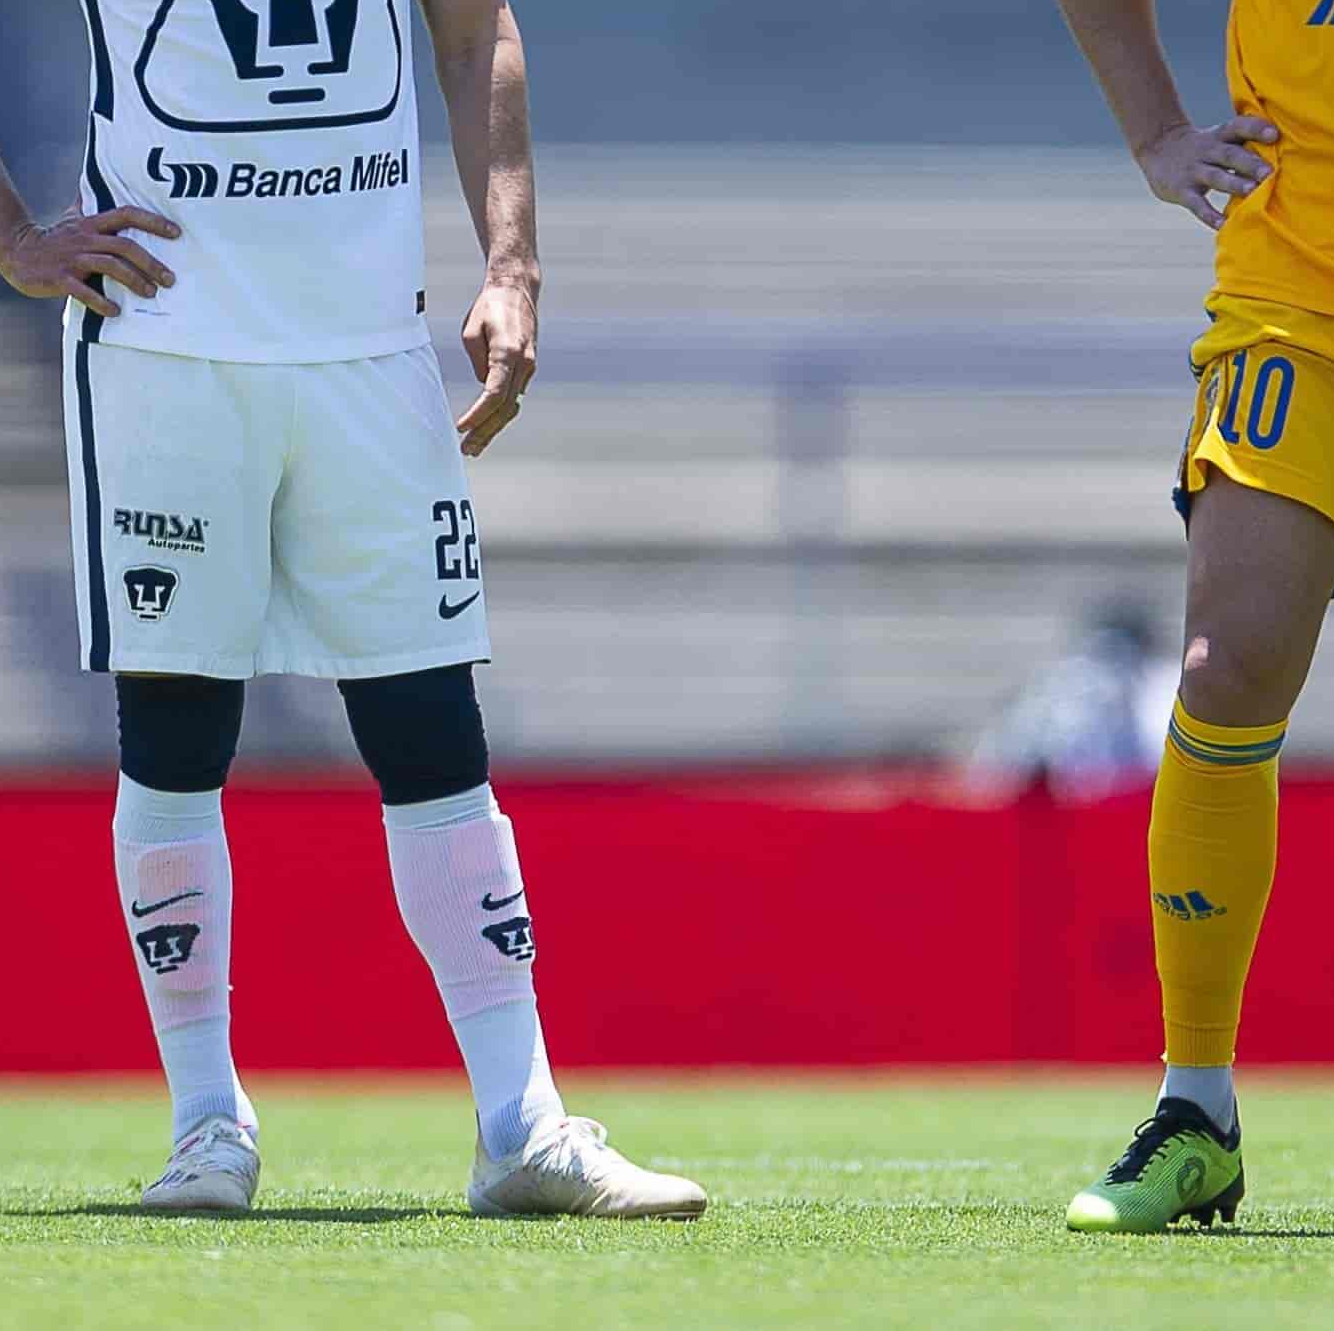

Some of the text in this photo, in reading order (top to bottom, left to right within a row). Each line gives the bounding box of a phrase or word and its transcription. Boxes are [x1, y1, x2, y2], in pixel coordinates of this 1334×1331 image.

[224, 148, 409, 198] Banca Mifel
[1219, 347, 1296, 450] 10
[432, 497, 480, 582] 22
